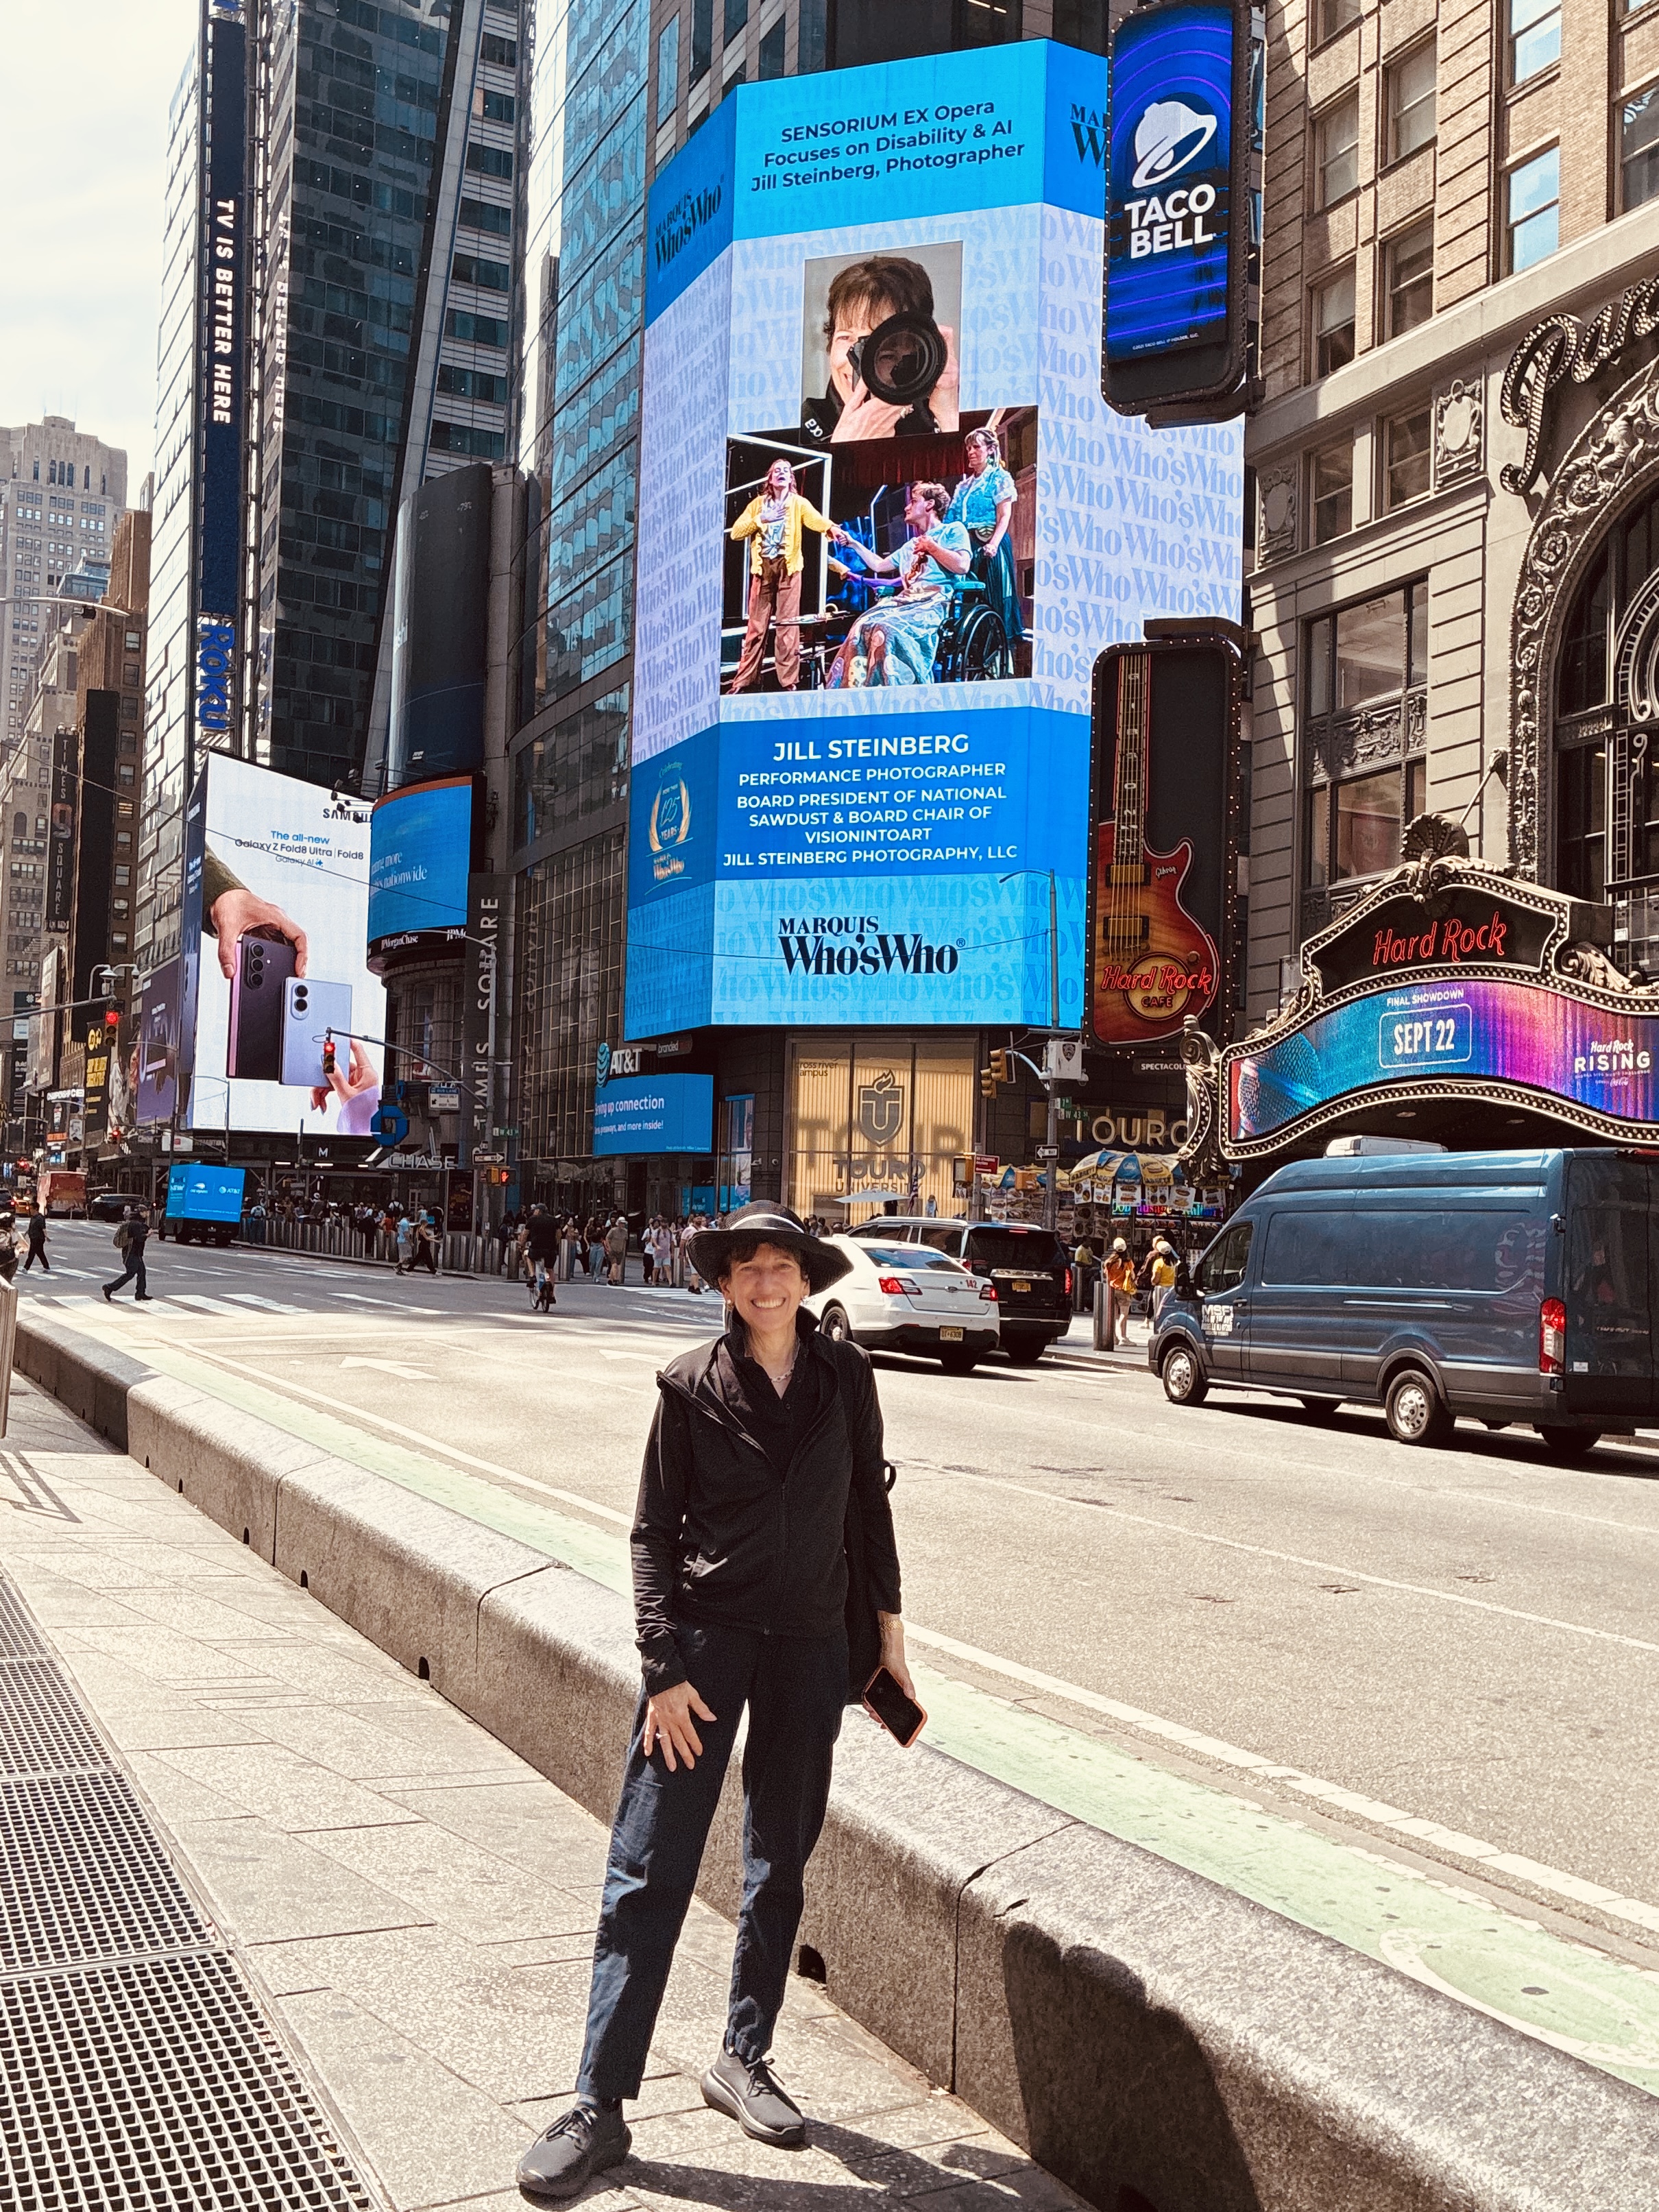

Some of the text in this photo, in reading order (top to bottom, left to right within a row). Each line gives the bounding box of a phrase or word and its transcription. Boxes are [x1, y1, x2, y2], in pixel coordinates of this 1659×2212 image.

[782, 101, 995, 143] SENSORIUM EX Opera
[764, 120, 1012, 167] Focuses on Disability & AI
[751, 143, 1025, 191] Jill Steinberg, Photographer
[655, 188, 692, 237] MARQUIS
[1124, 183, 1216, 230] TACO
[1130, 215, 1213, 259] BELL
[213, 200, 234, 424] TV IS BETTER HERE
[199, 623, 235, 730] ROKU
[773, 734, 969, 762] JILL STEINBERG
[739, 763, 1006, 786] PERFORMANCE PHOTOGRAPHER
[737, 786, 1006, 808] BOARD PRESIDENT OF NATIONAL
[749, 806, 992, 826] SAWDUST & BOARD CHAIR OF
[271, 830, 330, 845] The all-new
[805, 828, 932, 844] VISIONINTOART
[234, 839, 363, 860] Galaxy Z Fold8 Ultra Fold8
[723, 845, 1017, 866] JILL STEINBERG PHOTOGRAPHY, LLC
[276, 855, 305, 867] Galaxy
[55, 843, 64, 915] SQUARE
[384, 865, 428, 889] nationwide
[778, 916, 879, 937] MARQUIS
[380, 935, 419, 952] JPMorganChase
[1373, 911, 1507, 965] Hard Rock
[477, 898, 499, 1011] SQARE
[778, 934, 958, 976] Who'sWho
[1101, 965, 1212, 995] Hard Rock
[1141, 996, 1173, 1007] CAFE
[1386, 989, 1464, 1007] FINAL SHOWDOWN
[658, 1040, 679, 1054] branded
[1394, 1018, 1455, 1055] SEPT 22
[1590, 1039, 1634, 1054] Hard Rock
[609, 1048, 642, 1075] AT&T
[1575, 1051, 1650, 1073] RISING
[616, 1094, 664, 1112] connection
[642, 1120, 664, 1130] inside!
[1065, 1110, 1071, 1118] W
[1073, 1110, 1081, 1119] 43
[318, 1147, 328, 1157] M
[389, 1154, 458, 1170] CHASE
[833, 1159, 925, 1179] TOURO
[966, 1279, 978, 1288] 142
